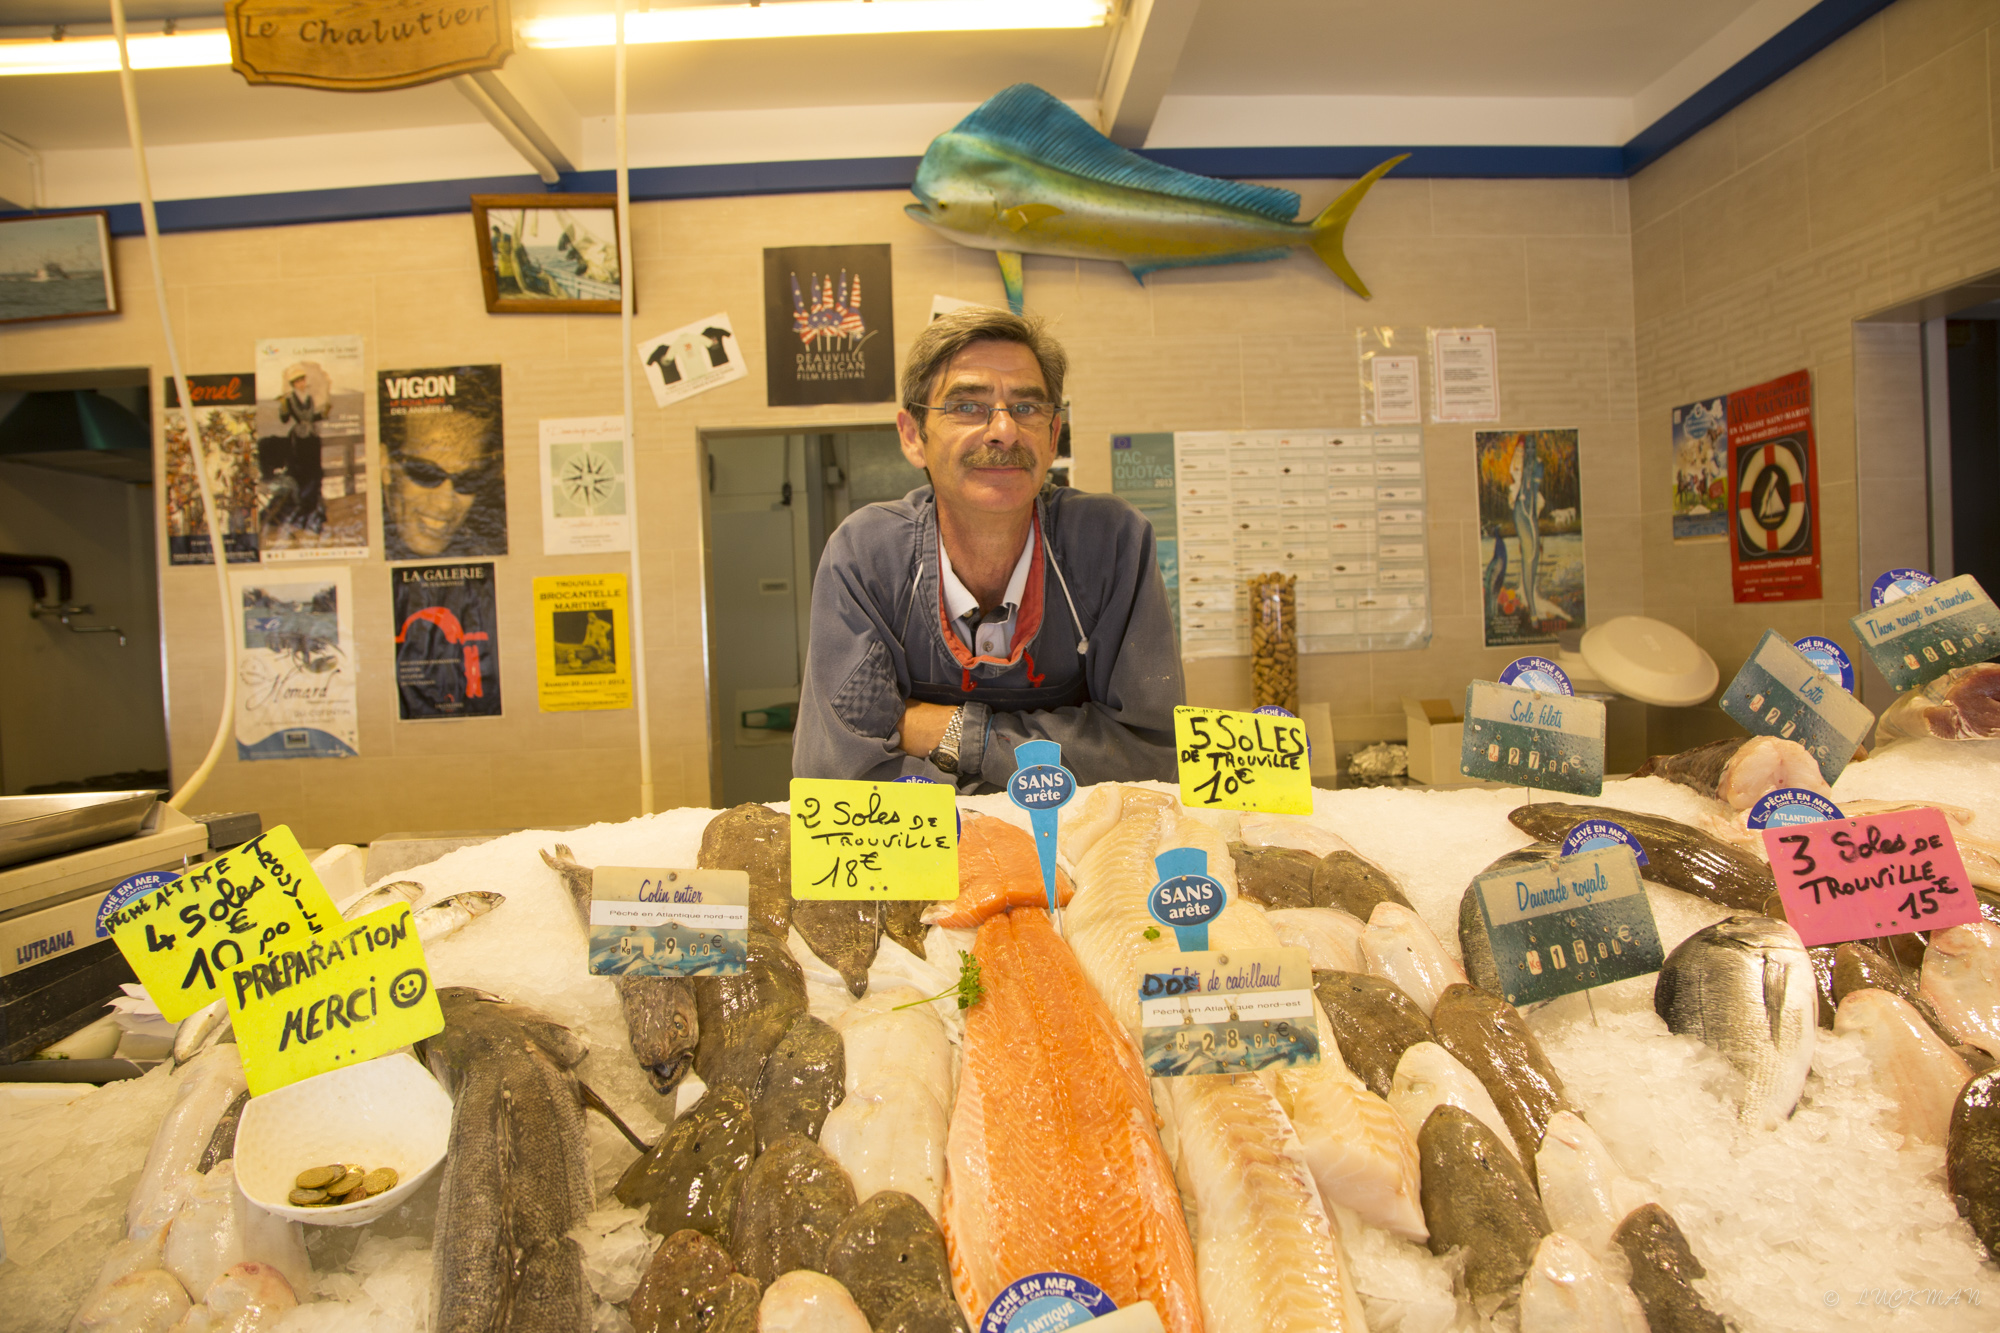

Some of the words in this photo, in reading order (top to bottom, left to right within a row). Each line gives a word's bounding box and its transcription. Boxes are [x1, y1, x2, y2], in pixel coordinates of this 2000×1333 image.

[244, 15, 278, 38] Le
[300, 5, 489, 44] Chalutier
[796, 351, 865, 364] DEAUVILLE
[797, 361, 865, 372] AMERICAN
[797, 372, 819, 381] FILM
[821, 371, 865, 379] FESTIVAL
[385, 375, 456, 399] VIGON
[1114, 451, 1141, 465] TAC
[1115, 464, 1173, 479] QUOTAS
[1154, 478, 1173, 488] 2013
[403, 571, 420, 582] LA
[423, 567, 484, 581] GALERIE
[540, 589, 621, 600] BROCANTELLE
[555, 601, 607, 610] MARITIME
[1866, 620, 1896, 639] Thon
[1896, 610, 1923, 627] rouge
[1924, 606, 1937, 616] en
[1934, 588, 1975, 610] tranches
[1825, 643, 1840, 656] MER
[1531, 659, 1555, 672] PÊCHÉ
[1554, 671, 1565, 681] EN
[1799, 676, 1824, 705] Lotte
[1510, 700, 1535, 723] Sole
[1539, 704, 1563, 728] filets
[1190, 717, 1211, 749] 5
[1181, 750, 1200, 763] DE
[1570, 755, 1582, 768] €
[1018, 772, 1064, 790] SANS
[1025, 790, 1061, 803] arête
[1764, 790, 1794, 809] PÊCHÉ
[1796, 793, 1810, 801] EN
[1813, 799, 1834, 815] MER
[797, 798, 821, 829] 2
[833, 793, 900, 826] Soles
[909, 815, 937, 830] DE
[1800, 800, 1824, 813] CAPTURE
[1774, 813, 1824, 823] ATLANTIQUE
[1569, 824, 1593, 847] ÉLEVÉ
[1594, 825, 1606, 833] EN
[1609, 827, 1628, 844] MER
[1779, 835, 1816, 875] 3
[1831, 825, 1907, 863] Soles
[1910, 835, 1943, 855] DE
[117, 882, 133, 896] EN
[135, 875, 160, 887] MER
[125, 884, 152, 897] CAPTURE
[241, 833, 323, 934] TROUVILL
[639, 879, 670, 903] Colin
[674, 885, 704, 903] entier
[1516, 877, 1569, 911] Daurade
[1572, 863, 1609, 903] royale
[1160, 883, 1214, 905] SANS
[145, 924, 176, 953] 4
[179, 875, 266, 938] Soles
[656, 911, 701, 919] Atlantique
[1169, 903, 1210, 920] arête
[711, 935, 723, 948] €
[1617, 925, 1632, 942] €
[17, 930, 75, 965] LUTRANA
[621, 947, 631, 955] Kg
[233, 910, 410, 1010] PRÉPARATION
[1207, 969, 1221, 992] de
[1226, 963, 1281, 990] cabillaud
[1258, 1001, 1301, 1009] nord-est
[1276, 1022, 1289, 1037] €
[987, 1287, 1020, 1333] PÊCHÉ
[1020, 1279, 1041, 1296] EN
[1044, 1277, 1076, 1292] MER
[1003, 1304, 1019, 1325] ZONE
[1018, 1296, 1029, 1306] DE
[1029, 1289, 1065, 1300] CAPTURE
